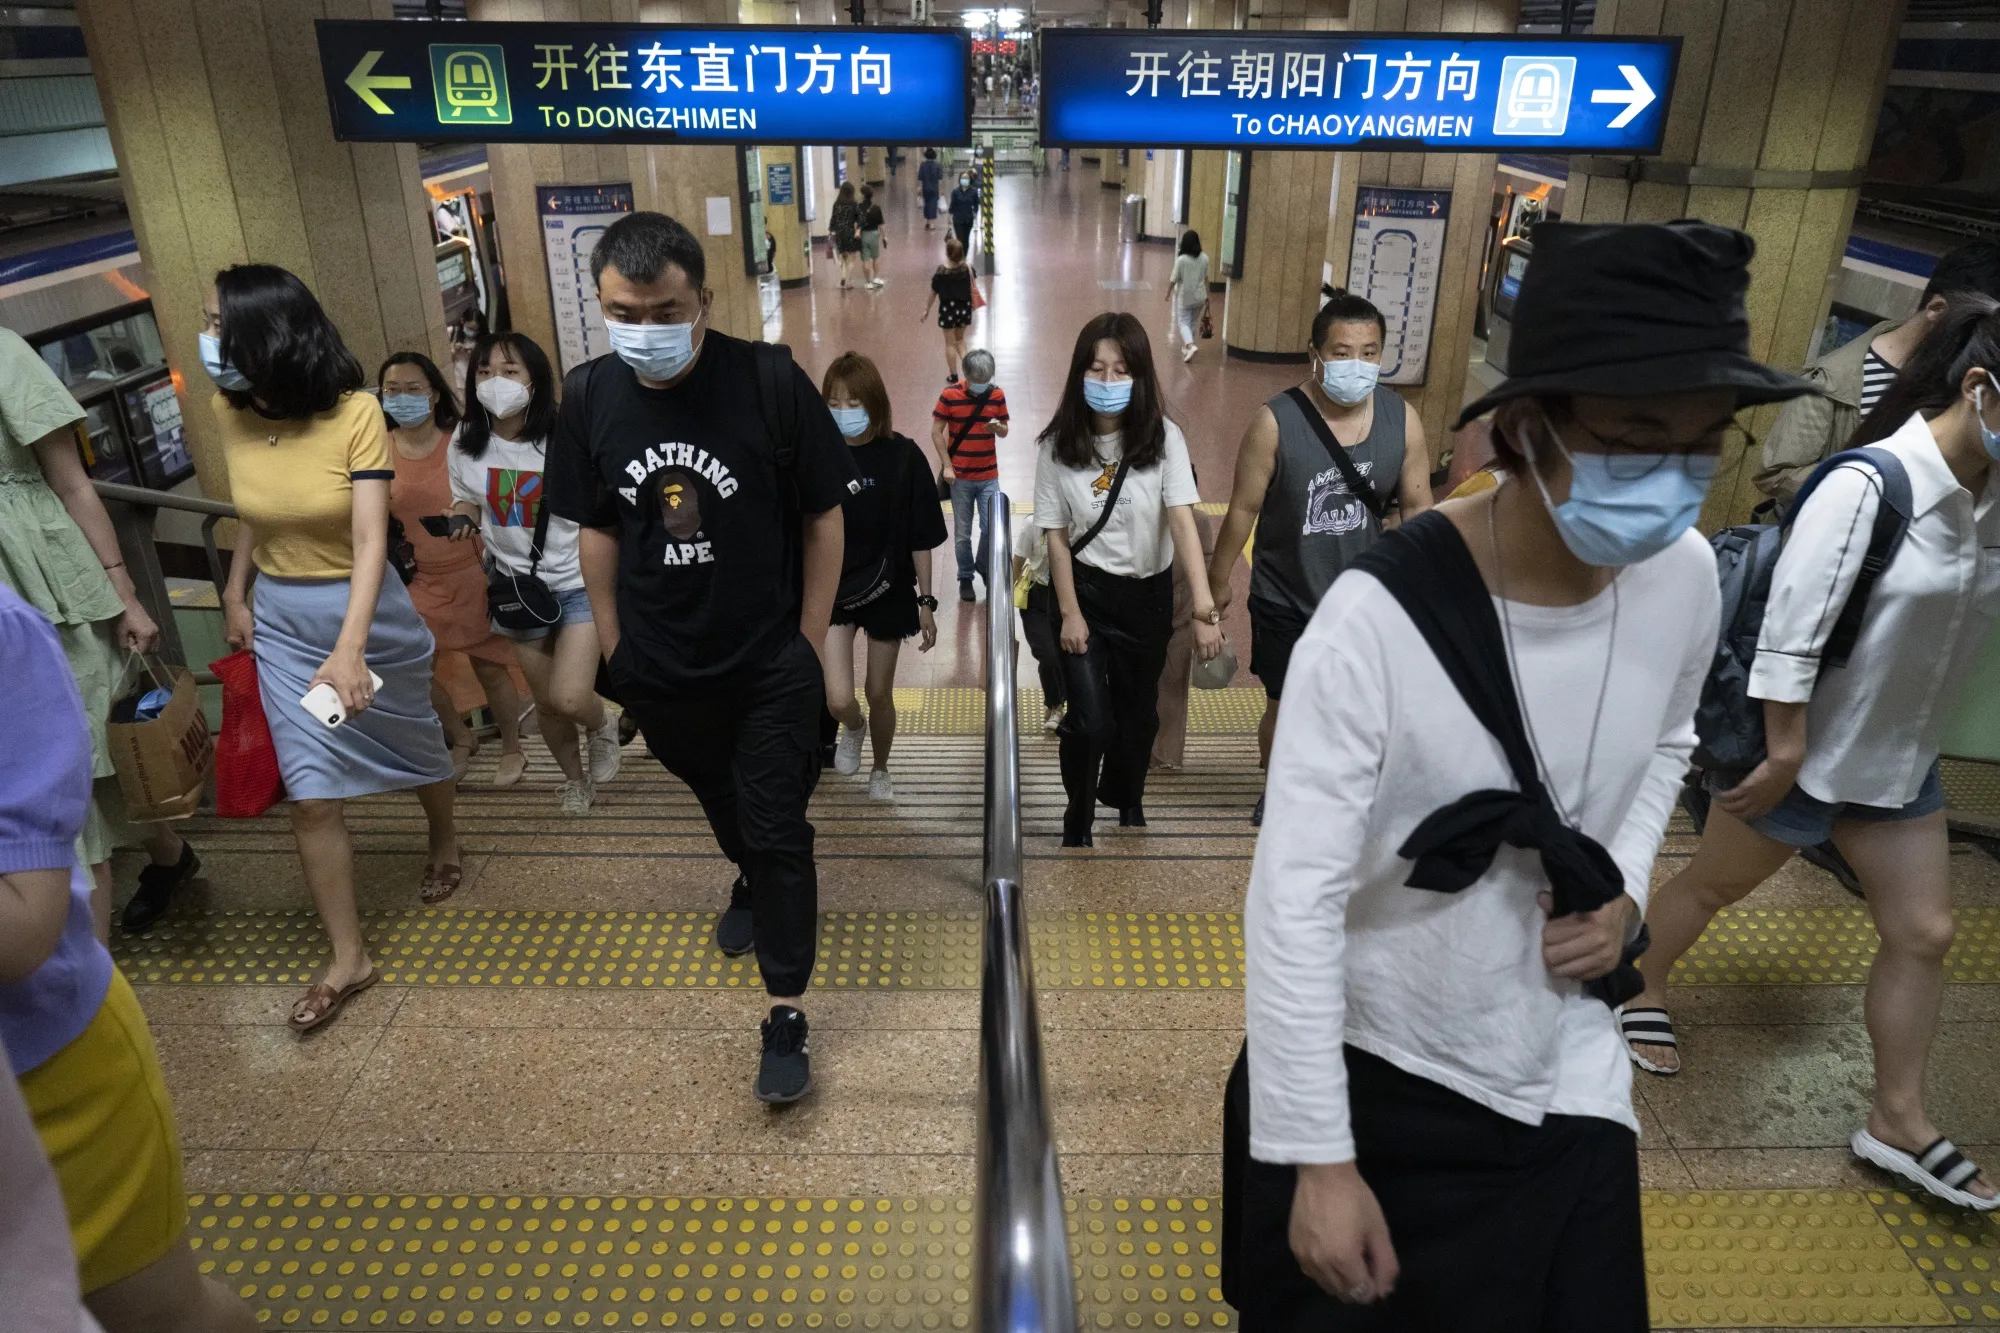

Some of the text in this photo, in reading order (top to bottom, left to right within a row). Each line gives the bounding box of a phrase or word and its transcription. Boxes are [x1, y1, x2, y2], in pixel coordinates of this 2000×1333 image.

[532, 42, 892, 95] 开往东直门方向
[1125, 49, 1481, 101] 开往朝阳门方向
[538, 106, 757, 129] To DONGZHIMEN
[1231, 113, 1474, 137] To CHAOYANGMEN
[618, 442, 739, 506] A BATHING
[663, 541, 715, 565] APE
